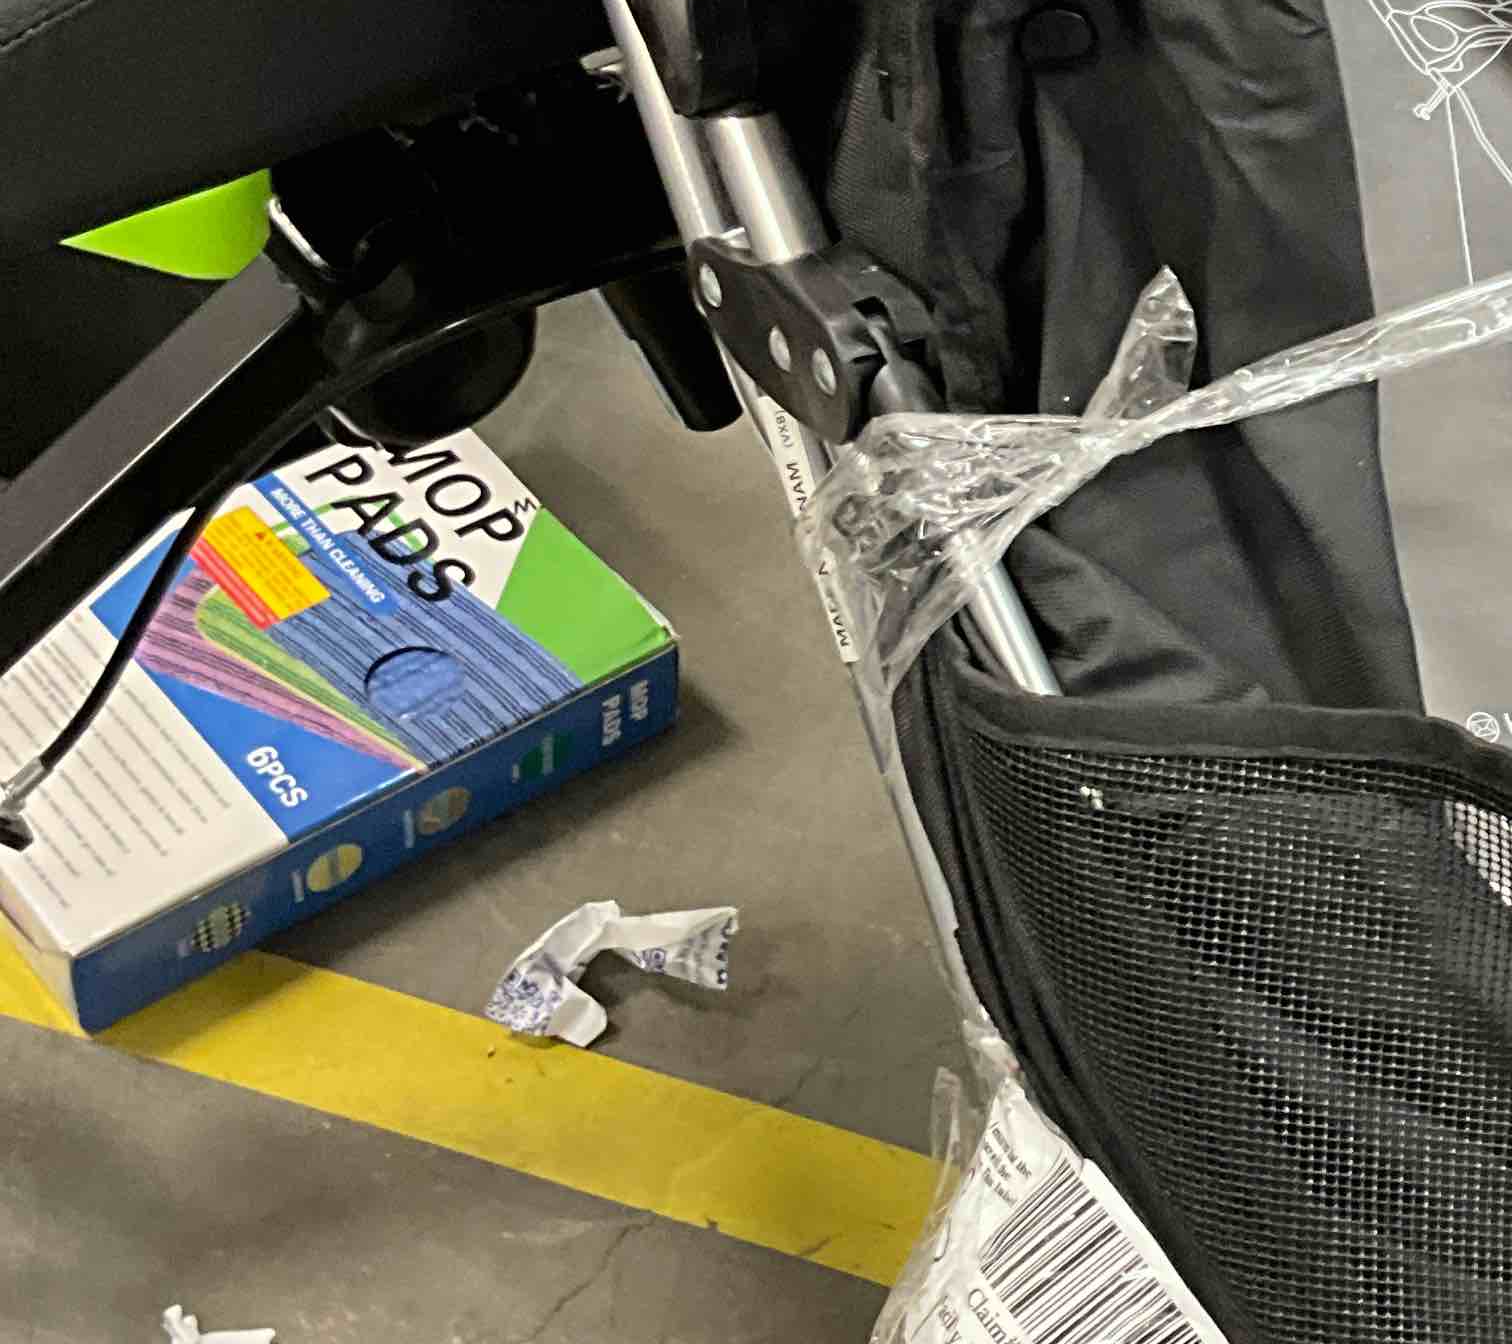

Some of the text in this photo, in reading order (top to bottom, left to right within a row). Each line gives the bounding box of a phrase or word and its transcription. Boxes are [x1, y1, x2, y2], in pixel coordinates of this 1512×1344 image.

[270, 487, 386, 604] MORE THAN CLEANING
[304, 453, 476, 603] PADS
[246, 745, 309, 808] 6PCS
